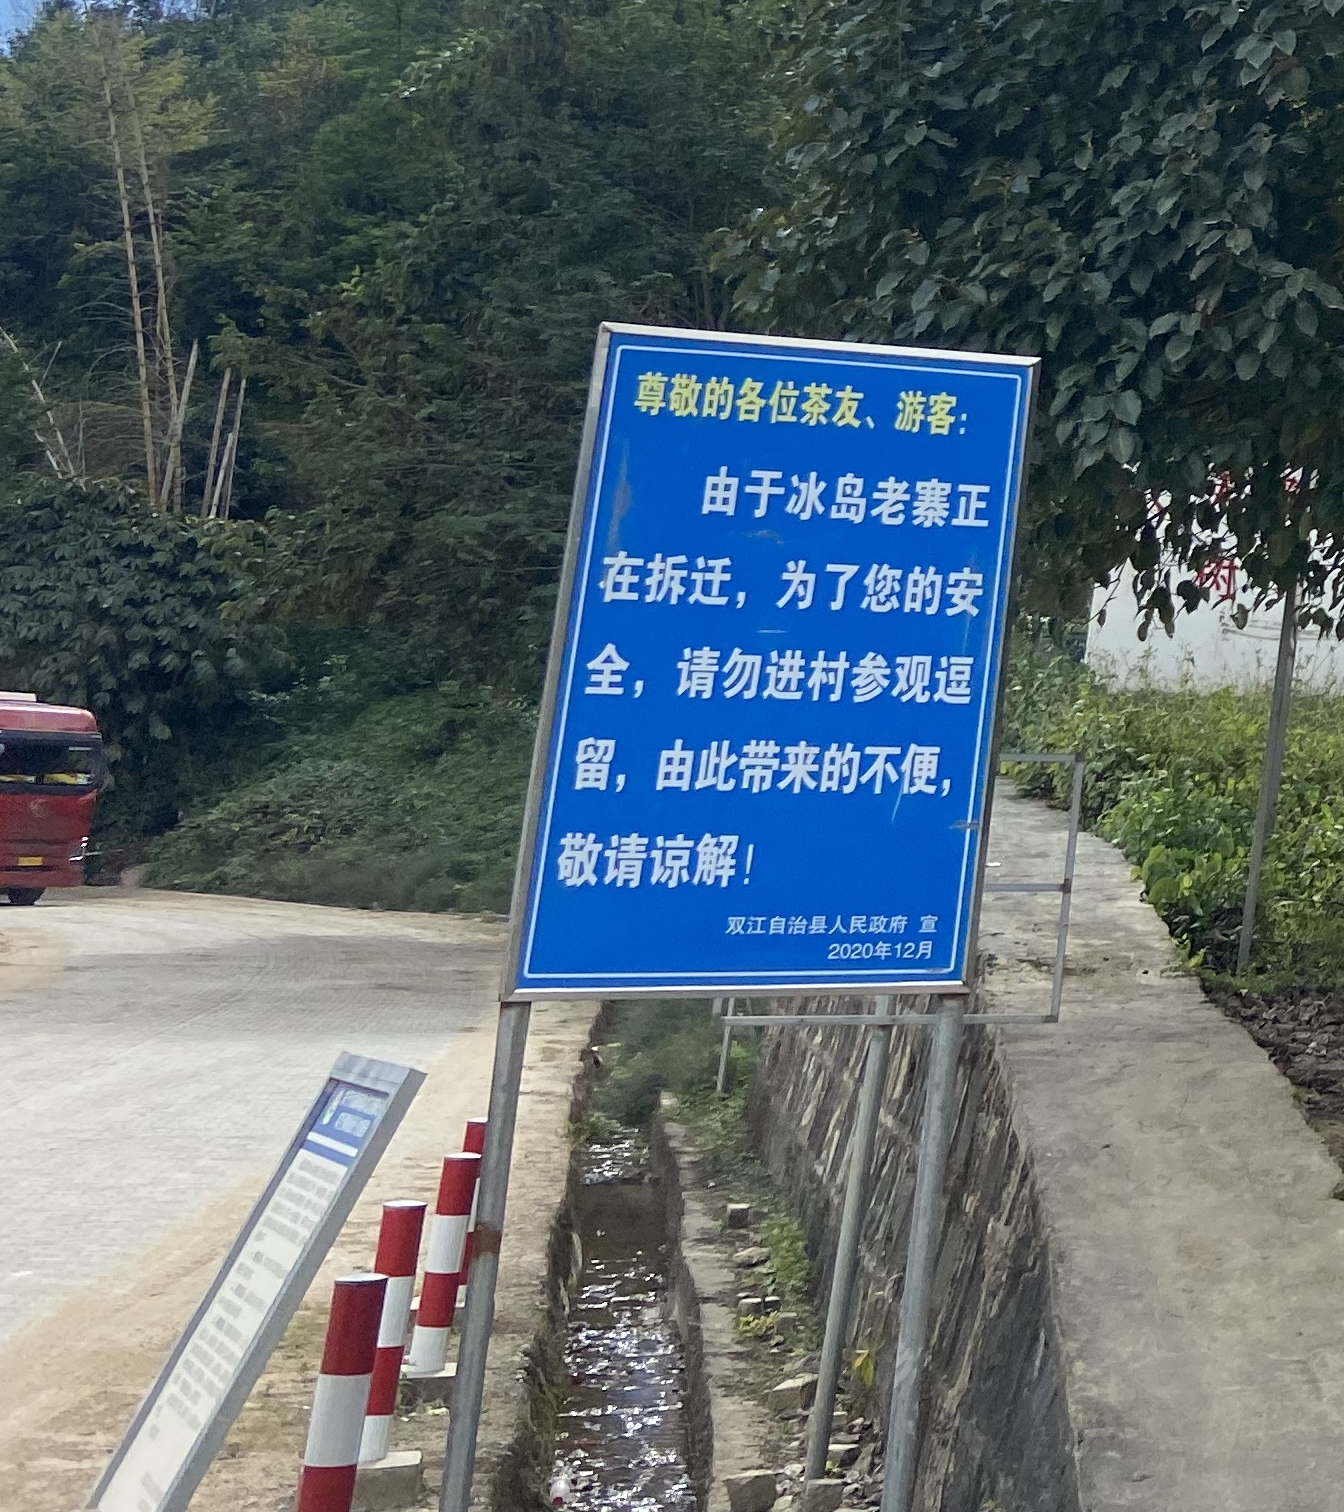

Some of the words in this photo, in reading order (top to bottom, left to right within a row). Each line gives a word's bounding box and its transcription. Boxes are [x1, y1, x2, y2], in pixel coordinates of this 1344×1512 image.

[702, 466, 991, 528] 由于冰岛老寨正
[725, 914, 908, 935] 双江自治县人民政府
[918, 914, 938, 933] 宣
[827, 941, 933, 960] 2020年12月
